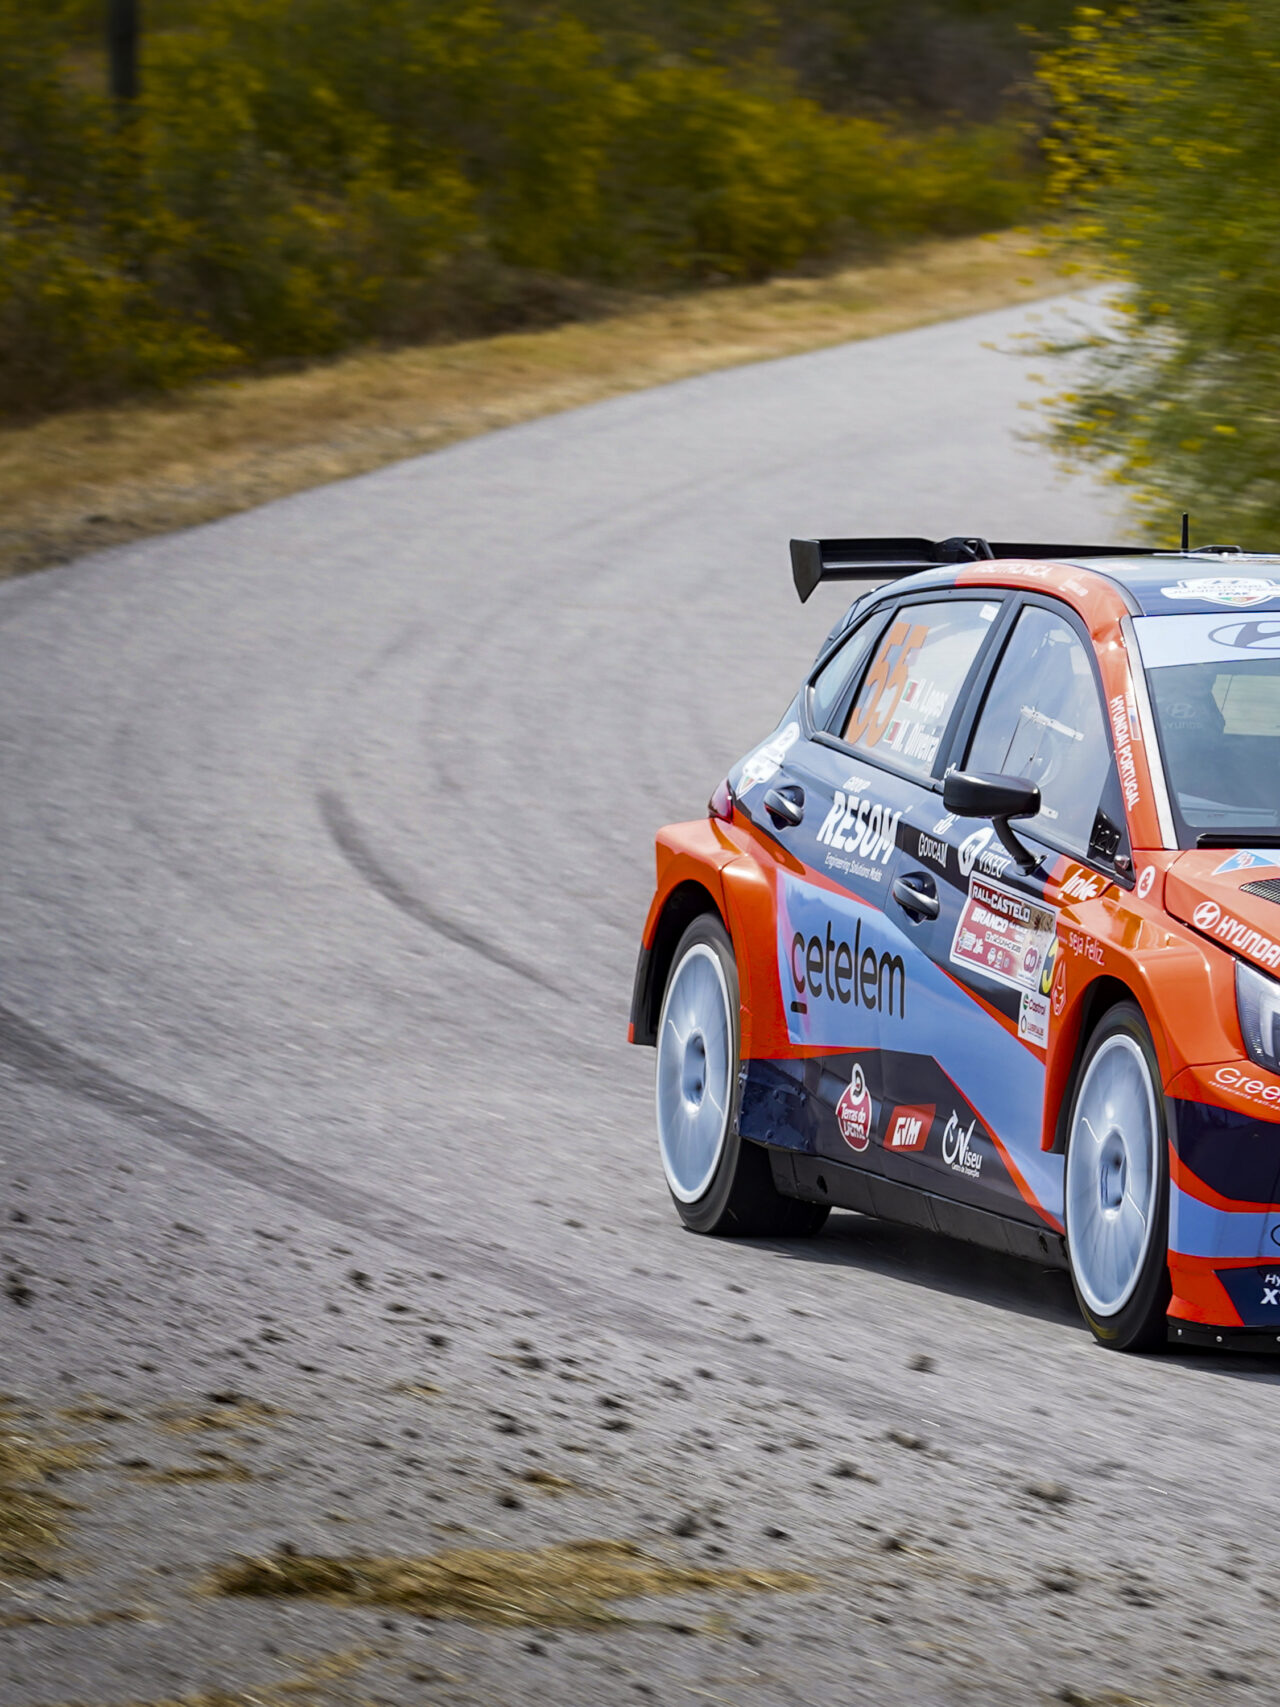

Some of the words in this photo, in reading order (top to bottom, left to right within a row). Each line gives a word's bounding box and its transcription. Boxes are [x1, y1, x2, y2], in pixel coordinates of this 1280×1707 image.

[847, 621, 930, 748] 55
[1110, 694, 1132, 749] HYUNDAI
[1119, 745, 1141, 812] PORTUGAL
[816, 791, 903, 865] RESOM
[979, 850, 1012, 879] VISEU
[970, 907, 1009, 934] BRANCO
[990, 894, 1031, 922] CASTELO
[790, 917, 906, 1020] cetelem
